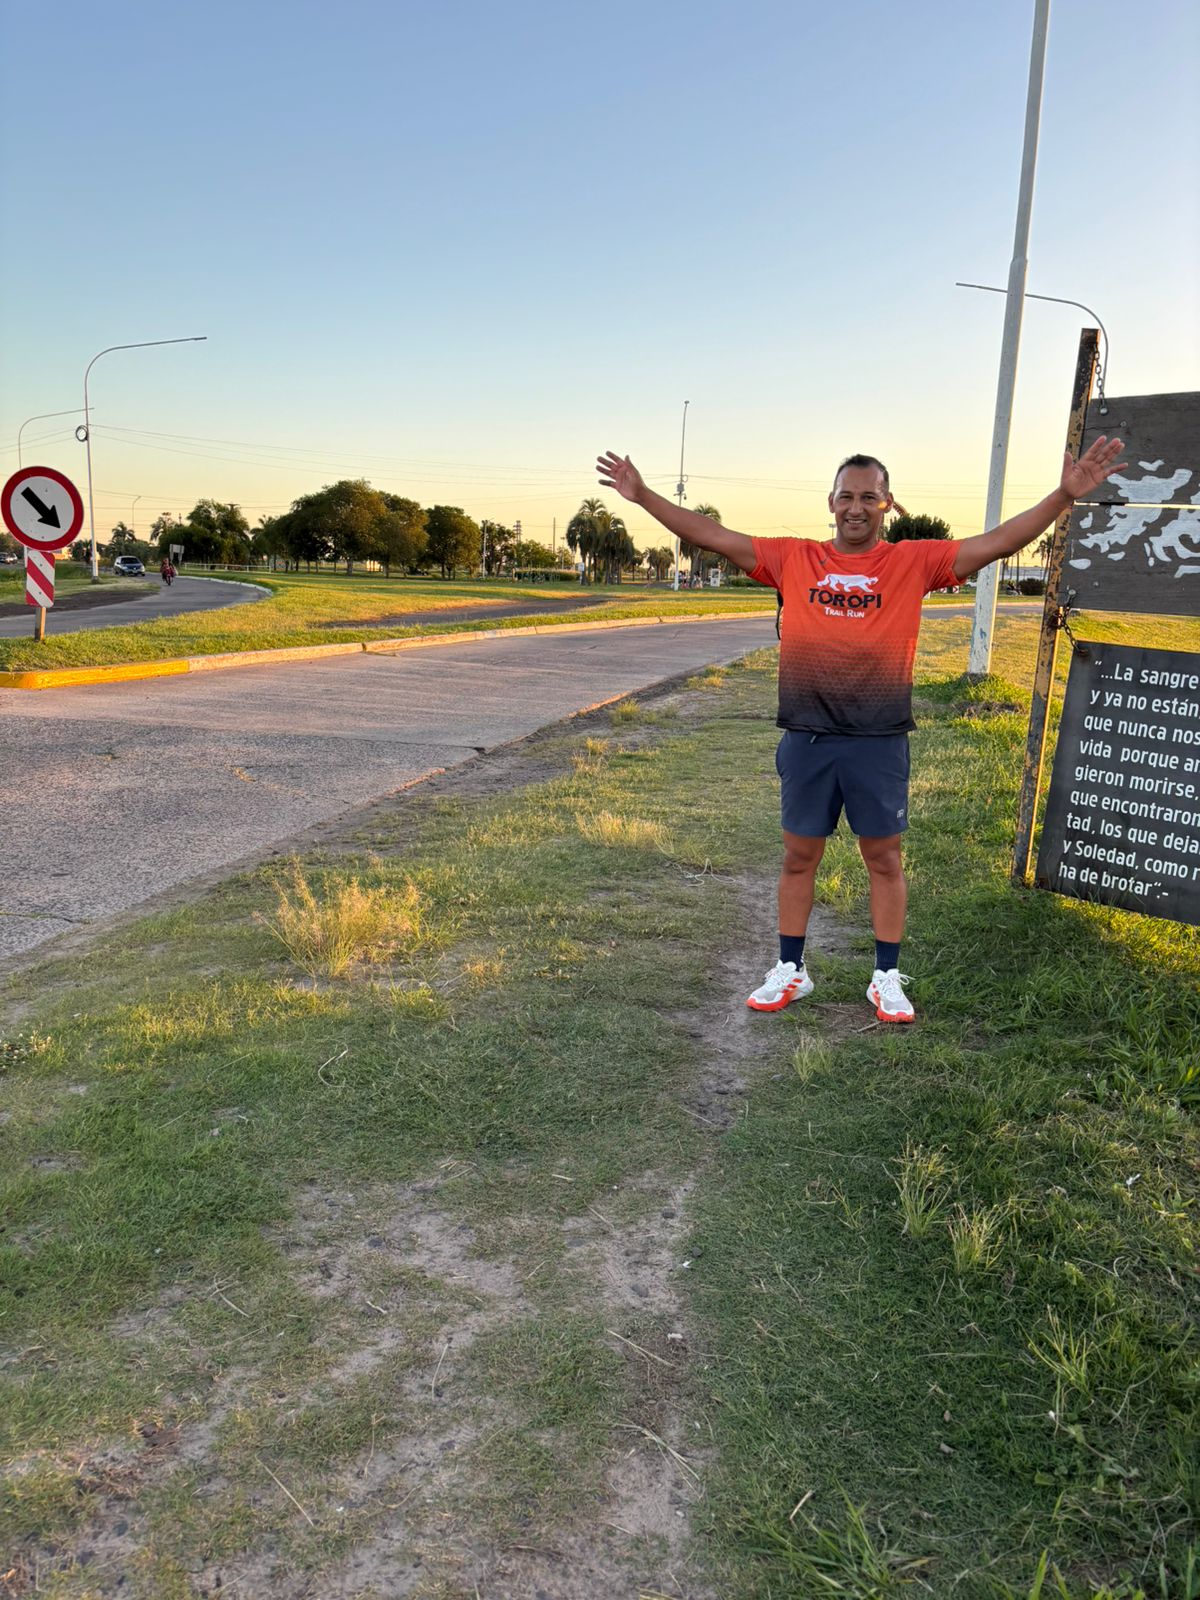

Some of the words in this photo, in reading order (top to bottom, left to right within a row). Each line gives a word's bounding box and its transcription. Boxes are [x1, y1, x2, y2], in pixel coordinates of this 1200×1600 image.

[808, 588, 882, 609] TOROPI
[1139, 669, 1199, 690] sangre
[1090, 689, 1101, 705] y
[1103, 691, 1123, 707] ya
[1126, 695, 1147, 710] no
[1084, 715, 1113, 732] que
[1117, 720, 1167, 741] nunca
[1172, 728, 1200, 746] nos
[1080, 739, 1112, 758] vida
[1120, 747, 1179, 770] porque
[1075, 764, 1124, 787] gieron
[1129, 774, 1199, 801] morirse,
[1070, 790, 1098, 808] que
[1101, 796, 1200, 828] encontraron
[1065, 812, 1096, 835] tad,
[1099, 819, 1122, 839] los
[1127, 827, 1158, 846] que
[1162, 832, 1200, 855] deja
[1058, 861, 1077, 880] ha
[1079, 867, 1099, 885] de
[1063, 839, 1072, 854] y
[1074, 840, 1139, 870] Soledad,
[1144, 858, 1188, 879] como
